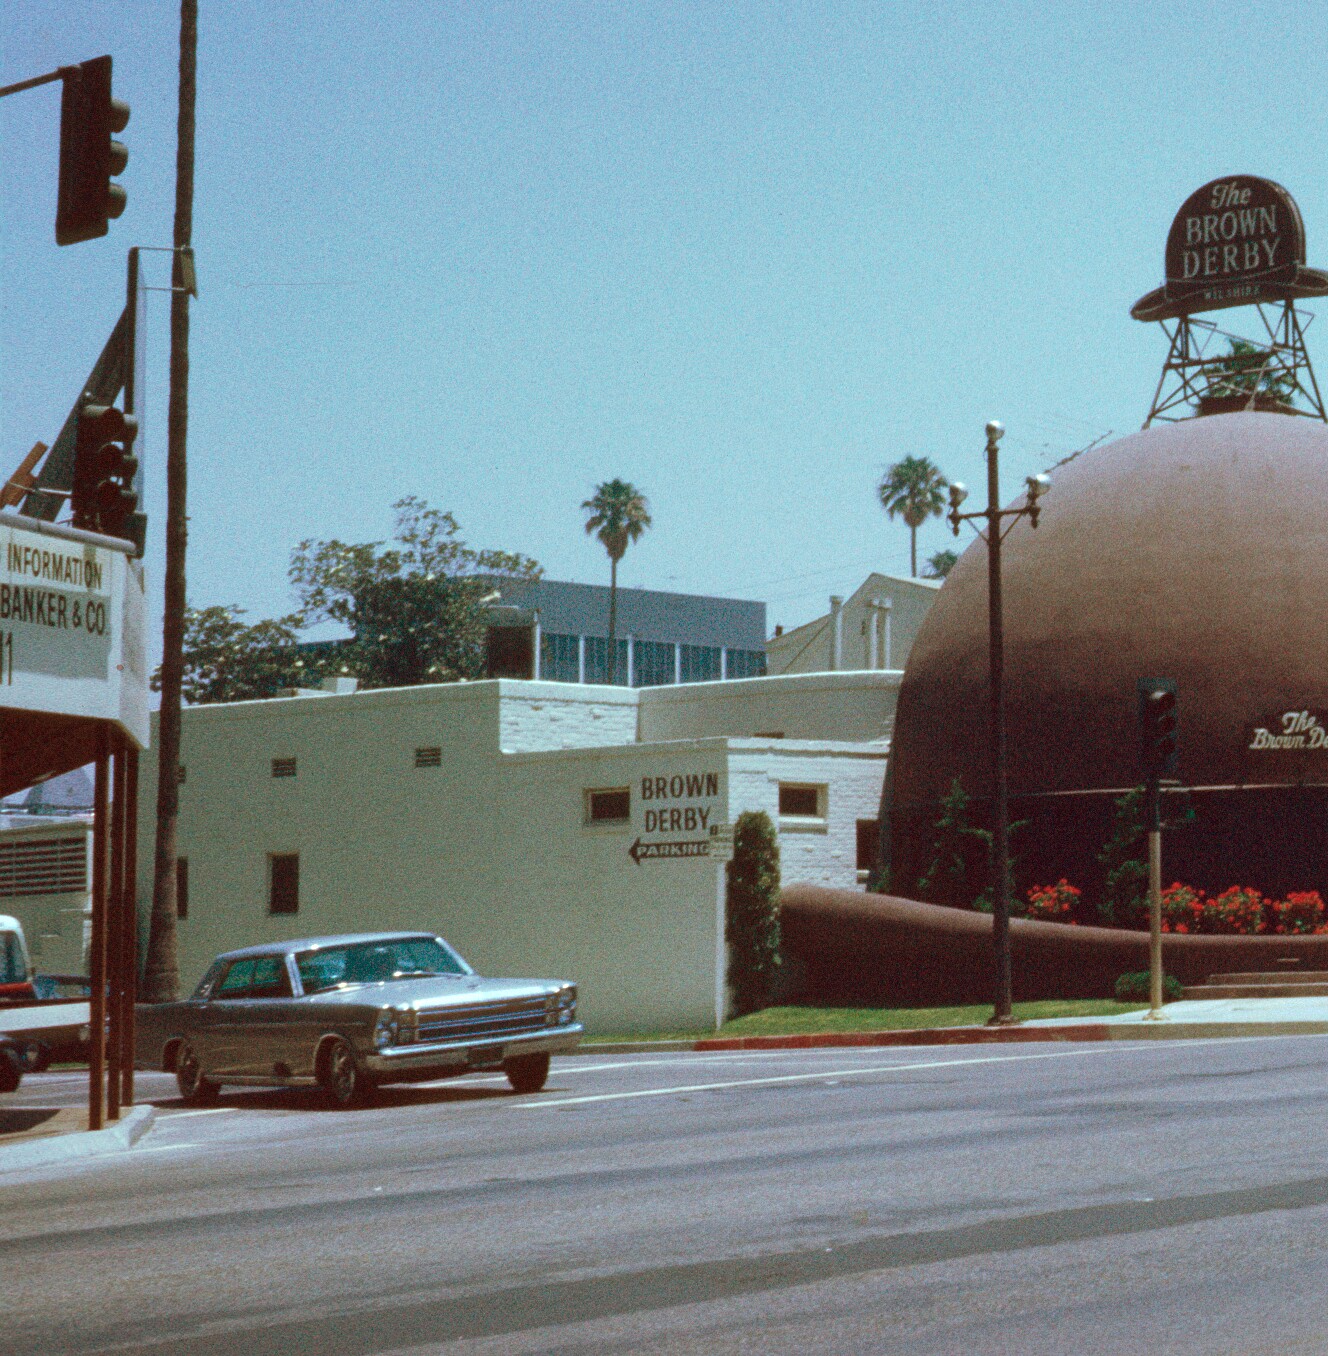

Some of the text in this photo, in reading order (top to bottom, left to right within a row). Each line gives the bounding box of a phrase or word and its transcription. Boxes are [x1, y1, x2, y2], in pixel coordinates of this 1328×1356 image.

[1211, 181, 1251, 208] The
[1186, 205, 1277, 246] BROWN
[1183, 238, 1279, 278] DERBY
[7, 543, 103, 590] INFORMATION
[0, 584, 67, 629] BANKER
[72, 601, 82, 628] &
[1281, 710, 1317, 734] The
[1248, 728, 1306, 750] Brown
[641, 773, 718, 800] BROWN
[645, 806, 711, 832] DERBY
